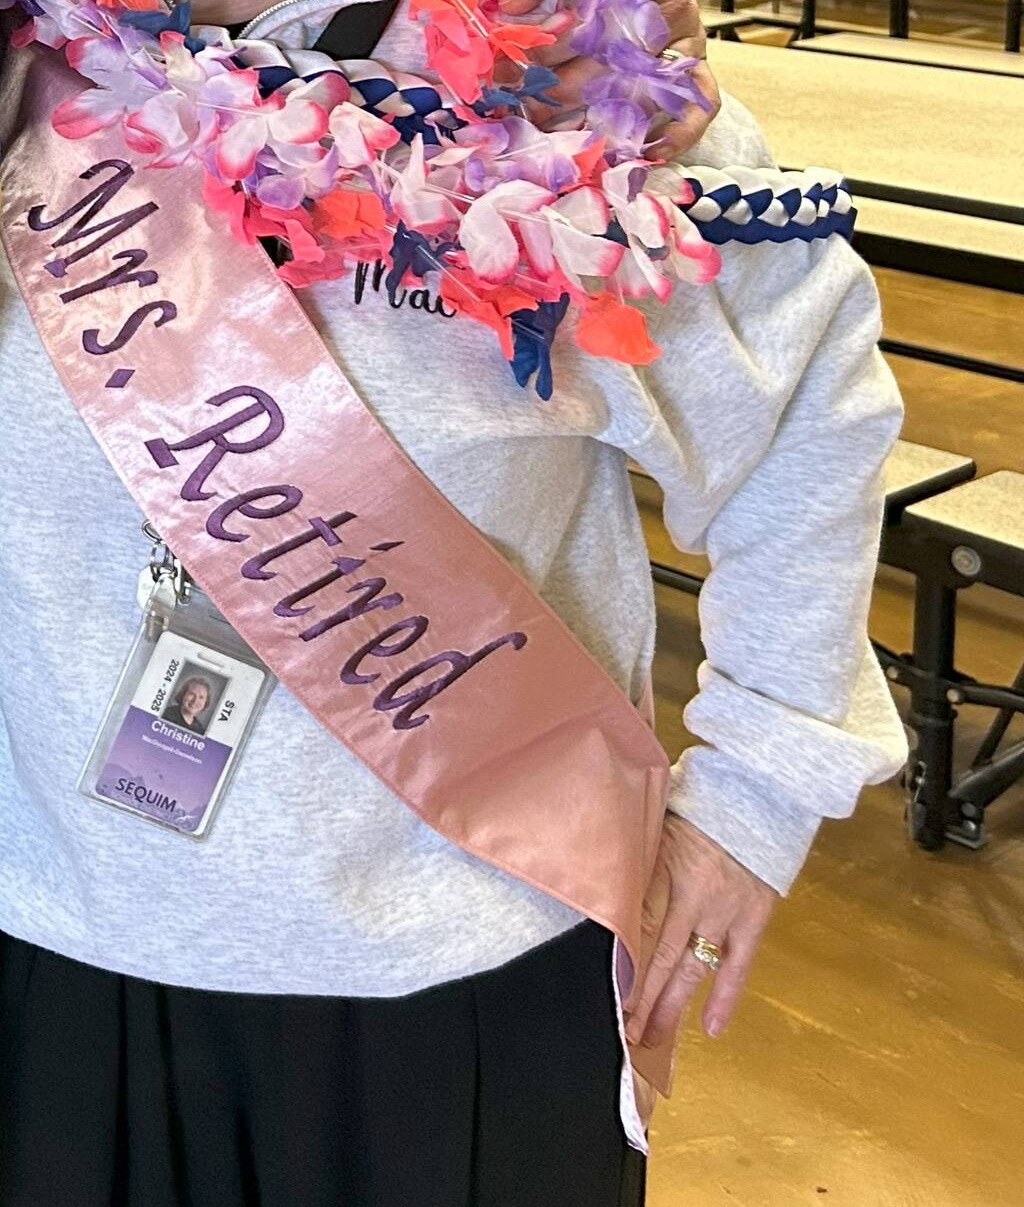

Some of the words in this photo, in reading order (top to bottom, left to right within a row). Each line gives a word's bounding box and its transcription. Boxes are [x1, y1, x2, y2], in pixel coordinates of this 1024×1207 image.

[27, 158, 178, 388] Mrs.
[144, 385, 528, 730] Retired
[164, 659, 180, 682] 2024
[151, 688, 167, 712] 2025
[217, 700, 235, 722] STA
[151, 720, 206, 751] Christine
[115, 778, 177, 812] SEQUIM
